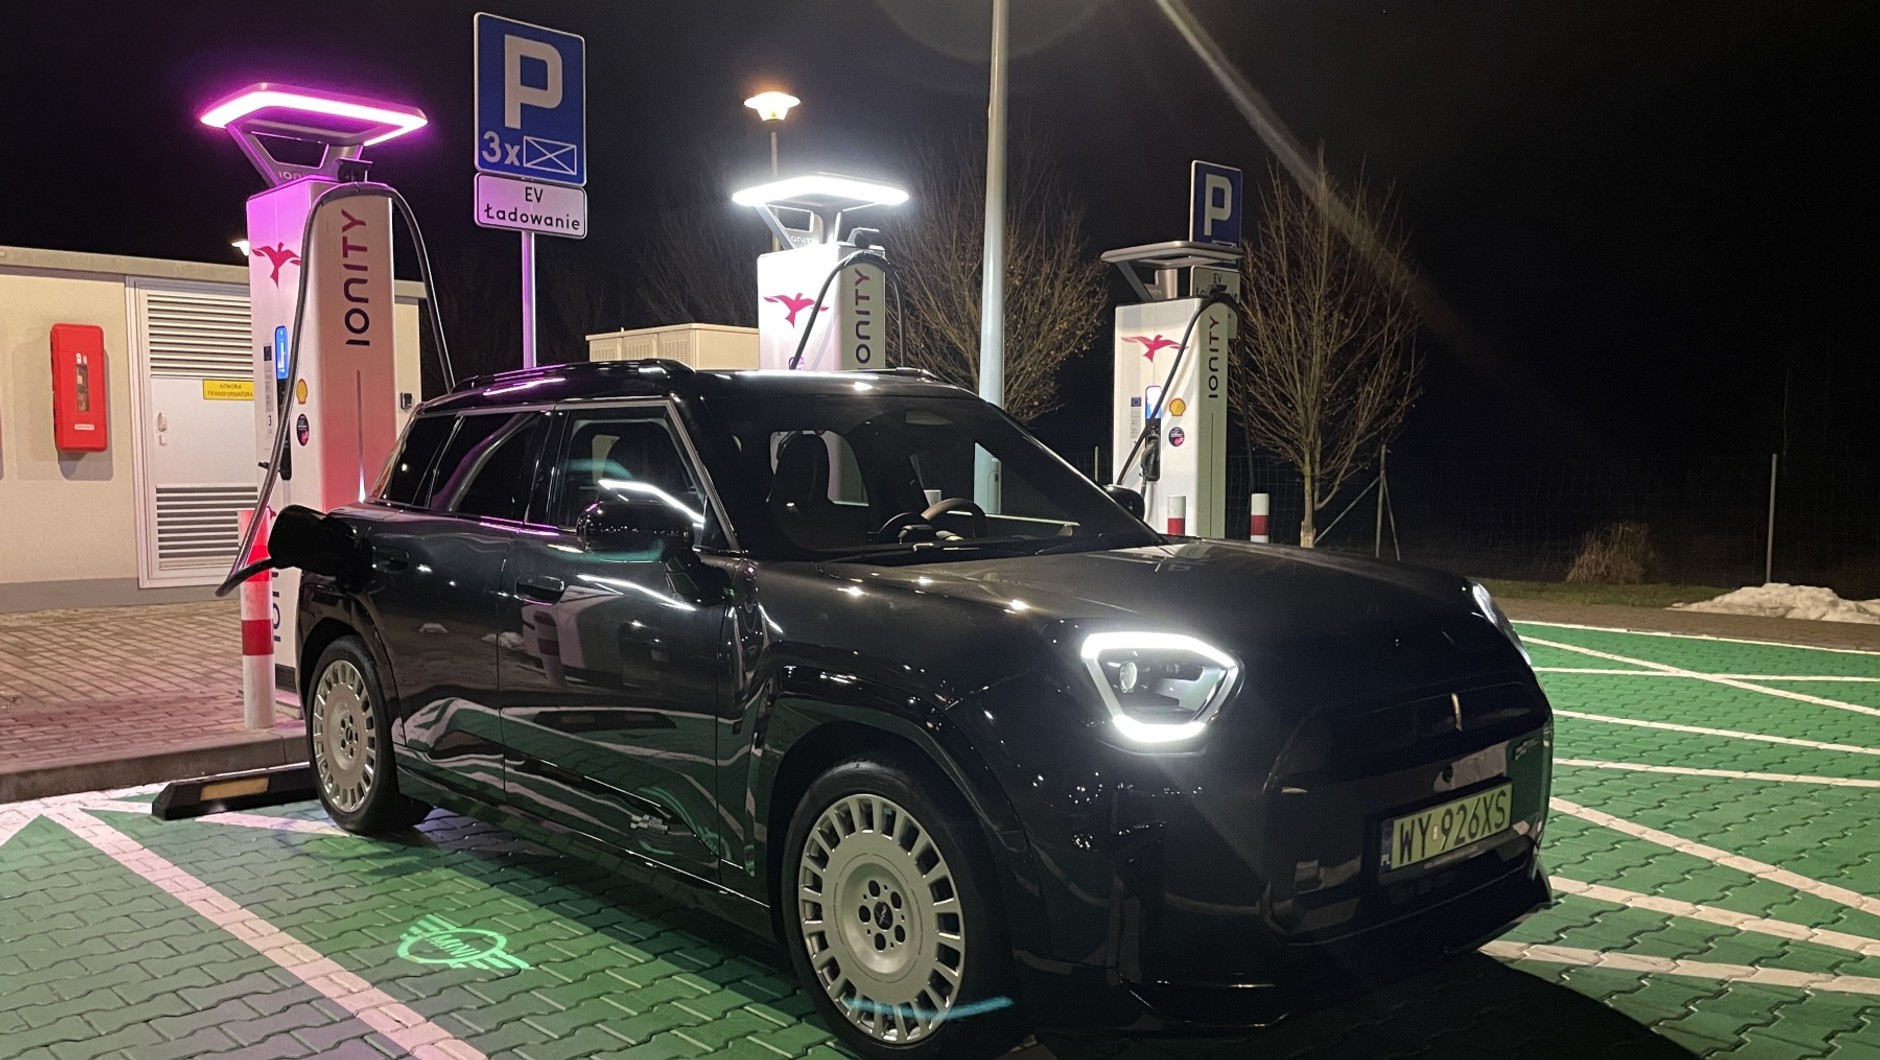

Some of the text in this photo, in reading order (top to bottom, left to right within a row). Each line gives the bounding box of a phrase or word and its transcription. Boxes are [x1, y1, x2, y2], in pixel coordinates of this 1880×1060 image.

[504, 34, 563, 130] P
[484, 203, 580, 231] Ładowanie
[524, 186, 544, 203] EV
[1204, 173, 1232, 236] P
[341, 208, 371, 347] IONITY
[1213, 272, 1223, 284] EV
[854, 267, 871, 365] ONITY
[1208, 315, 1220, 399] IONITY
[1400, 813, 1432, 864] WY
[1440, 789, 1506, 851] 926XS
